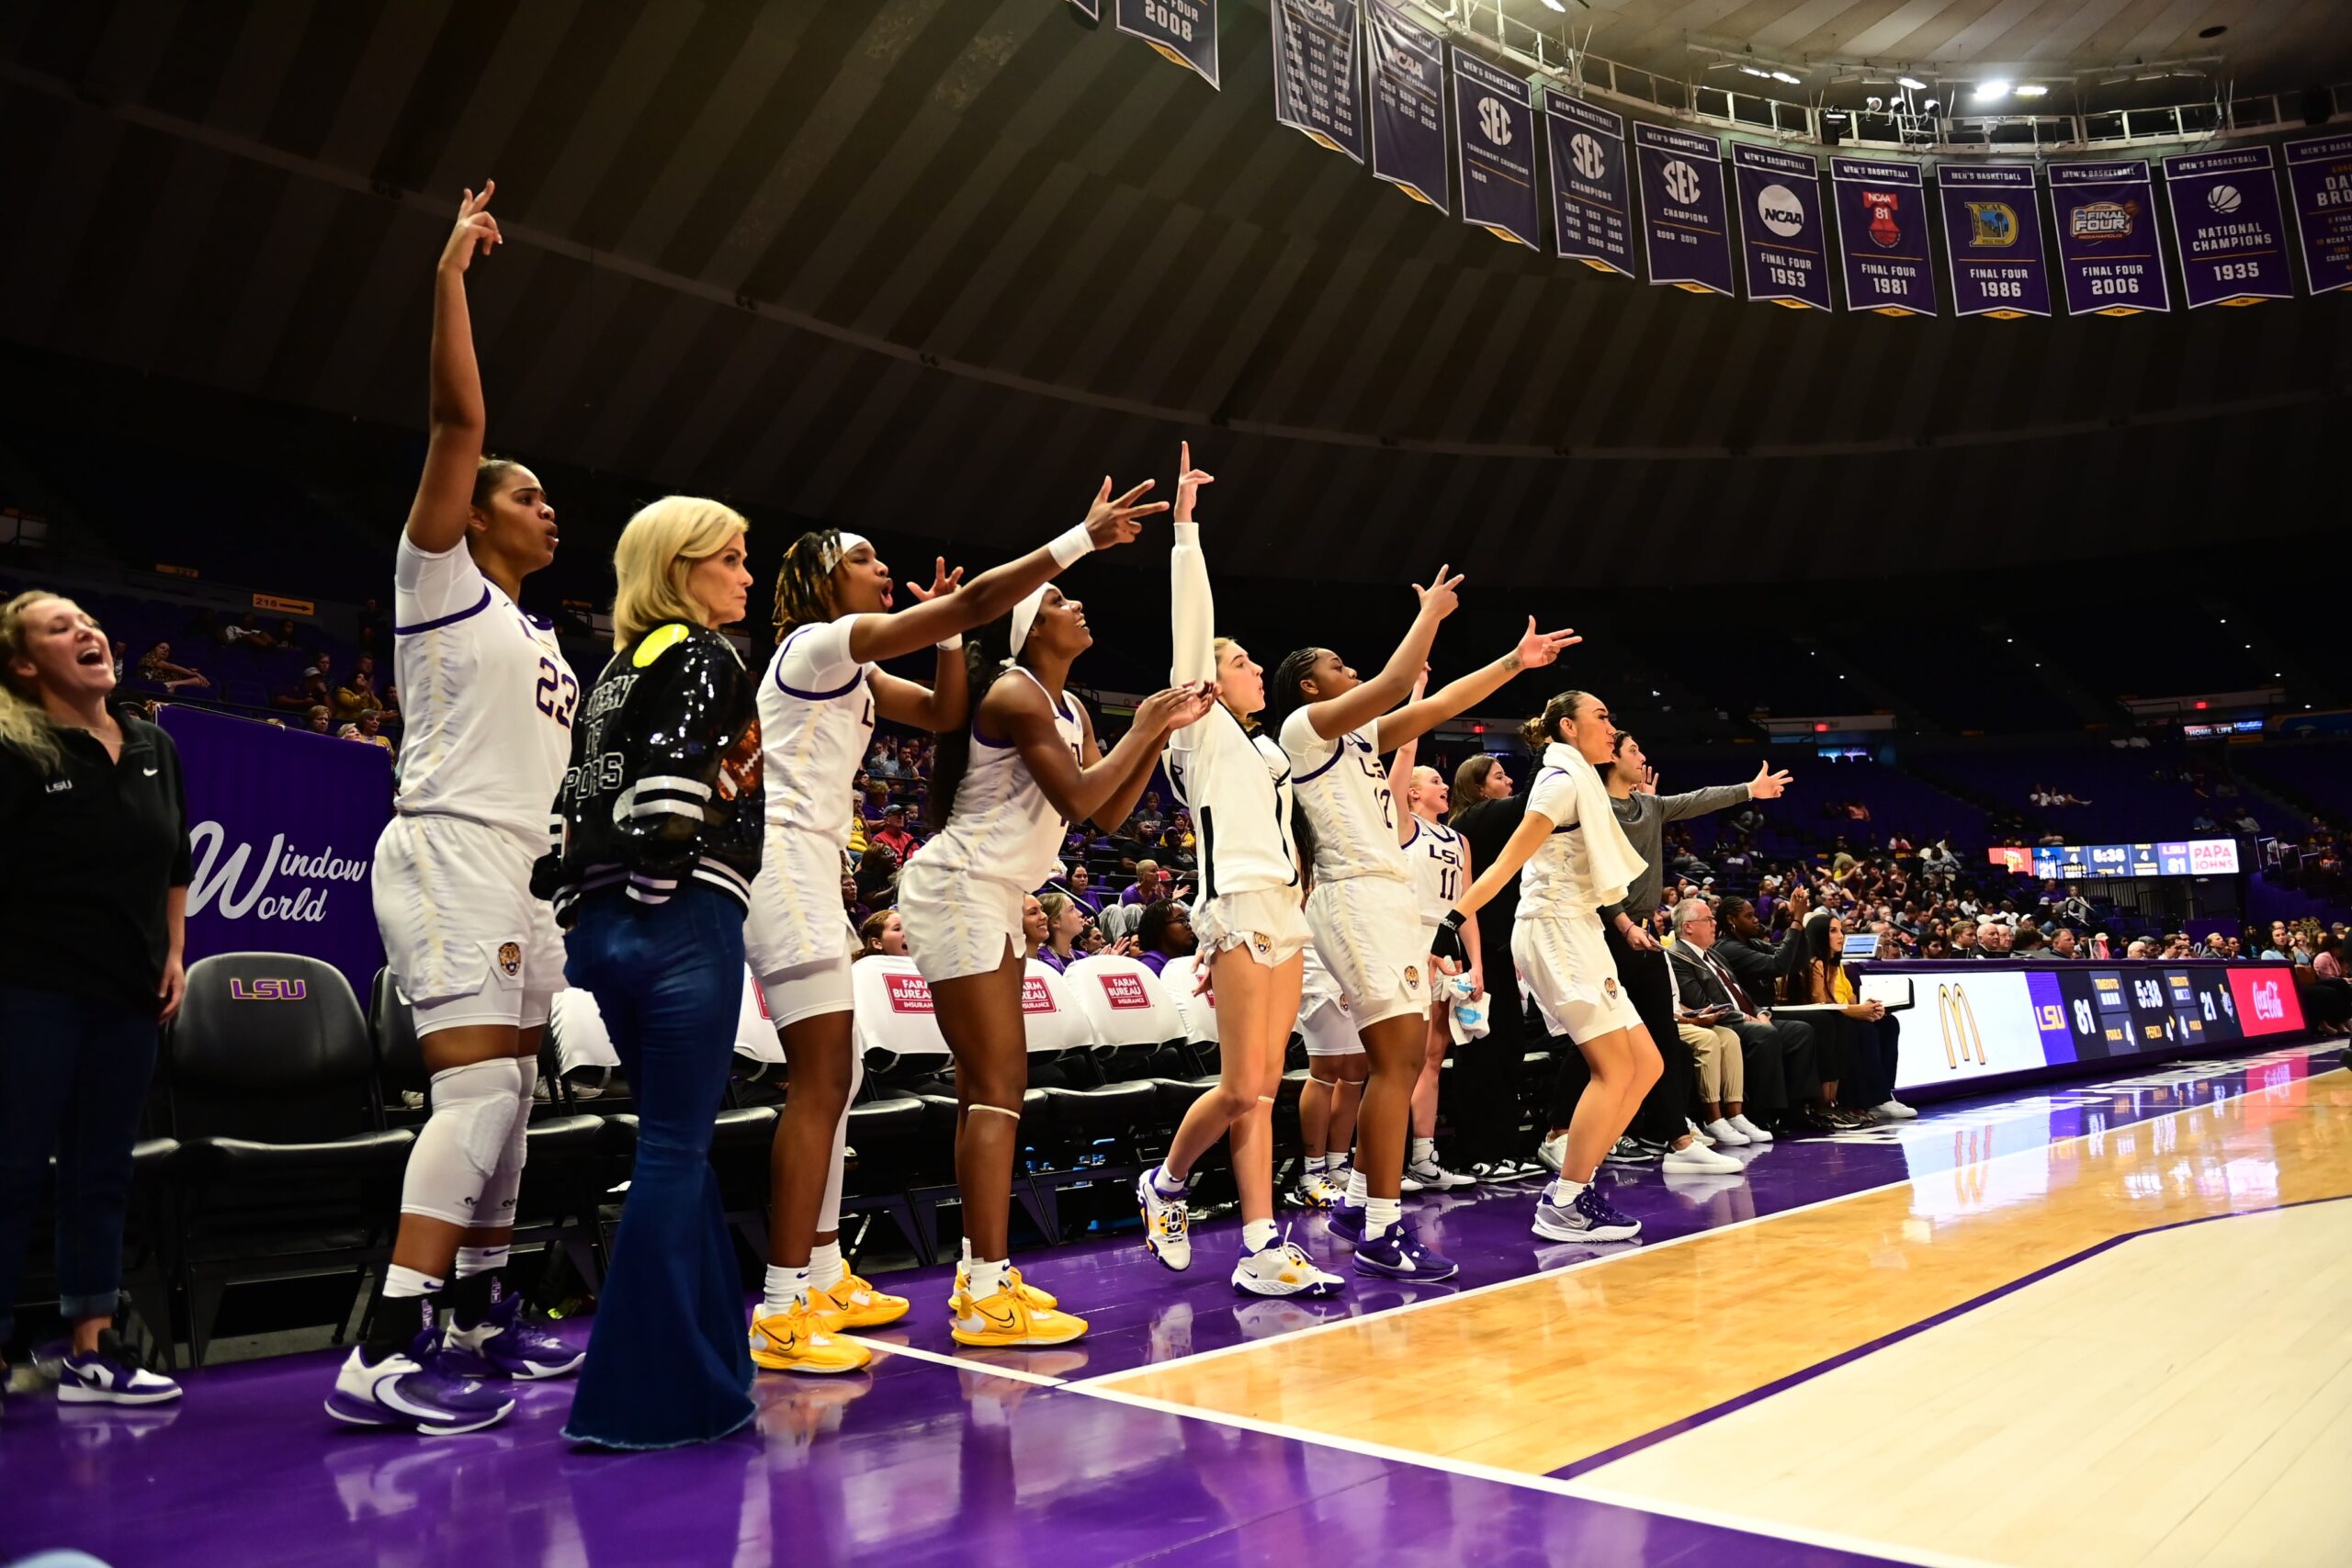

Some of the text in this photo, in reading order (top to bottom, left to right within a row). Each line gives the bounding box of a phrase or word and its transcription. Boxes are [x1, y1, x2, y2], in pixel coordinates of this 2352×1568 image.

[1171, 0, 1199, 22] FOUR
[1145, 4, 1193, 42] 2008
[1464, 61, 1521, 95] MEN'S BASKETBALL
[1477, 96, 1512, 145] SEC
[1555, 100, 1612, 128] MEN'S BASKETBALL
[1646, 132, 1710, 152] MEN'S BASKETBALL
[2301, 141, 2352, 154] MEN'S BASK
[1571, 133, 1605, 179] SEC
[1744, 152, 1806, 170] MEN'S BASKETBALL
[2178, 155, 2256, 171] MEN'S BASKETBALL
[1500, 158, 1529, 175] CHAMPIONS
[1843, 165, 1909, 178] MEN'S BASKETBALL
[2062, 168, 2135, 178] MEN'S BASKETBALL
[1663, 161, 1701, 204] SEC
[1951, 172, 2021, 181] MEN'S BASKETBALL
[2325, 174, 2352, 191] DA
[1571, 180, 1611, 201] CHAMPIONS
[1868, 193, 1891, 203] NCAA
[1663, 208, 1708, 223] CHAMPIONS
[1765, 208, 1803, 226] NCAA
[1875, 207, 1889, 220] 81
[2087, 211, 2124, 220] FINAL
[2075, 220, 2125, 231] FOUR
[2198, 222, 2263, 239] NATIONAL
[2192, 233, 2272, 252] CHAMPIONS
[1760, 252, 1812, 270] FINAL FOUR
[1770, 267, 1806, 288] 1953
[1861, 264, 1917, 277] FINAL FOUR
[1970, 268, 2029, 278] FINAL FOUR
[2082, 265, 2143, 276] FINAL FOUR
[2213, 262, 2259, 281] 1935
[1873, 277, 1907, 295] 1981
[1980, 281, 2021, 297] 1986
[2091, 278, 2139, 295] 2006
[537, 657, 577, 728] 23
[2189, 728, 2211, 736] HOME
[1359, 757, 1388, 781] LS
[46, 780, 73, 793] LSU
[2141, 851, 2149, 861] 4
[2162, 845, 2186, 854] LSU
[2194, 845, 2232, 858] PAPA
[2168, 858, 2186, 874] 81
[2195, 860, 2233, 870] JOHNS
[1440, 868, 1456, 900] 11
[231, 978, 307, 1000] LSU
[1023, 981, 1043, 990] ARM
[1113, 977, 1138, 987] FARM
[892, 988, 933, 999] BUREA
[1022, 989, 1047, 1000] REAU
[1107, 987, 1142, 997] BUREAU
[2134, 979, 2163, 1009] 5:38
[2199, 991, 2217, 1021] 21
[2035, 1005, 2065, 1031] LSU
[2074, 998, 2096, 1034] 81
[2106, 1028, 2123, 1041] FOULS
[2125, 1021, 2135, 1046] 4
[2165, 1022, 2174, 1041] 4
[2180, 1015, 2189, 1039] 4
